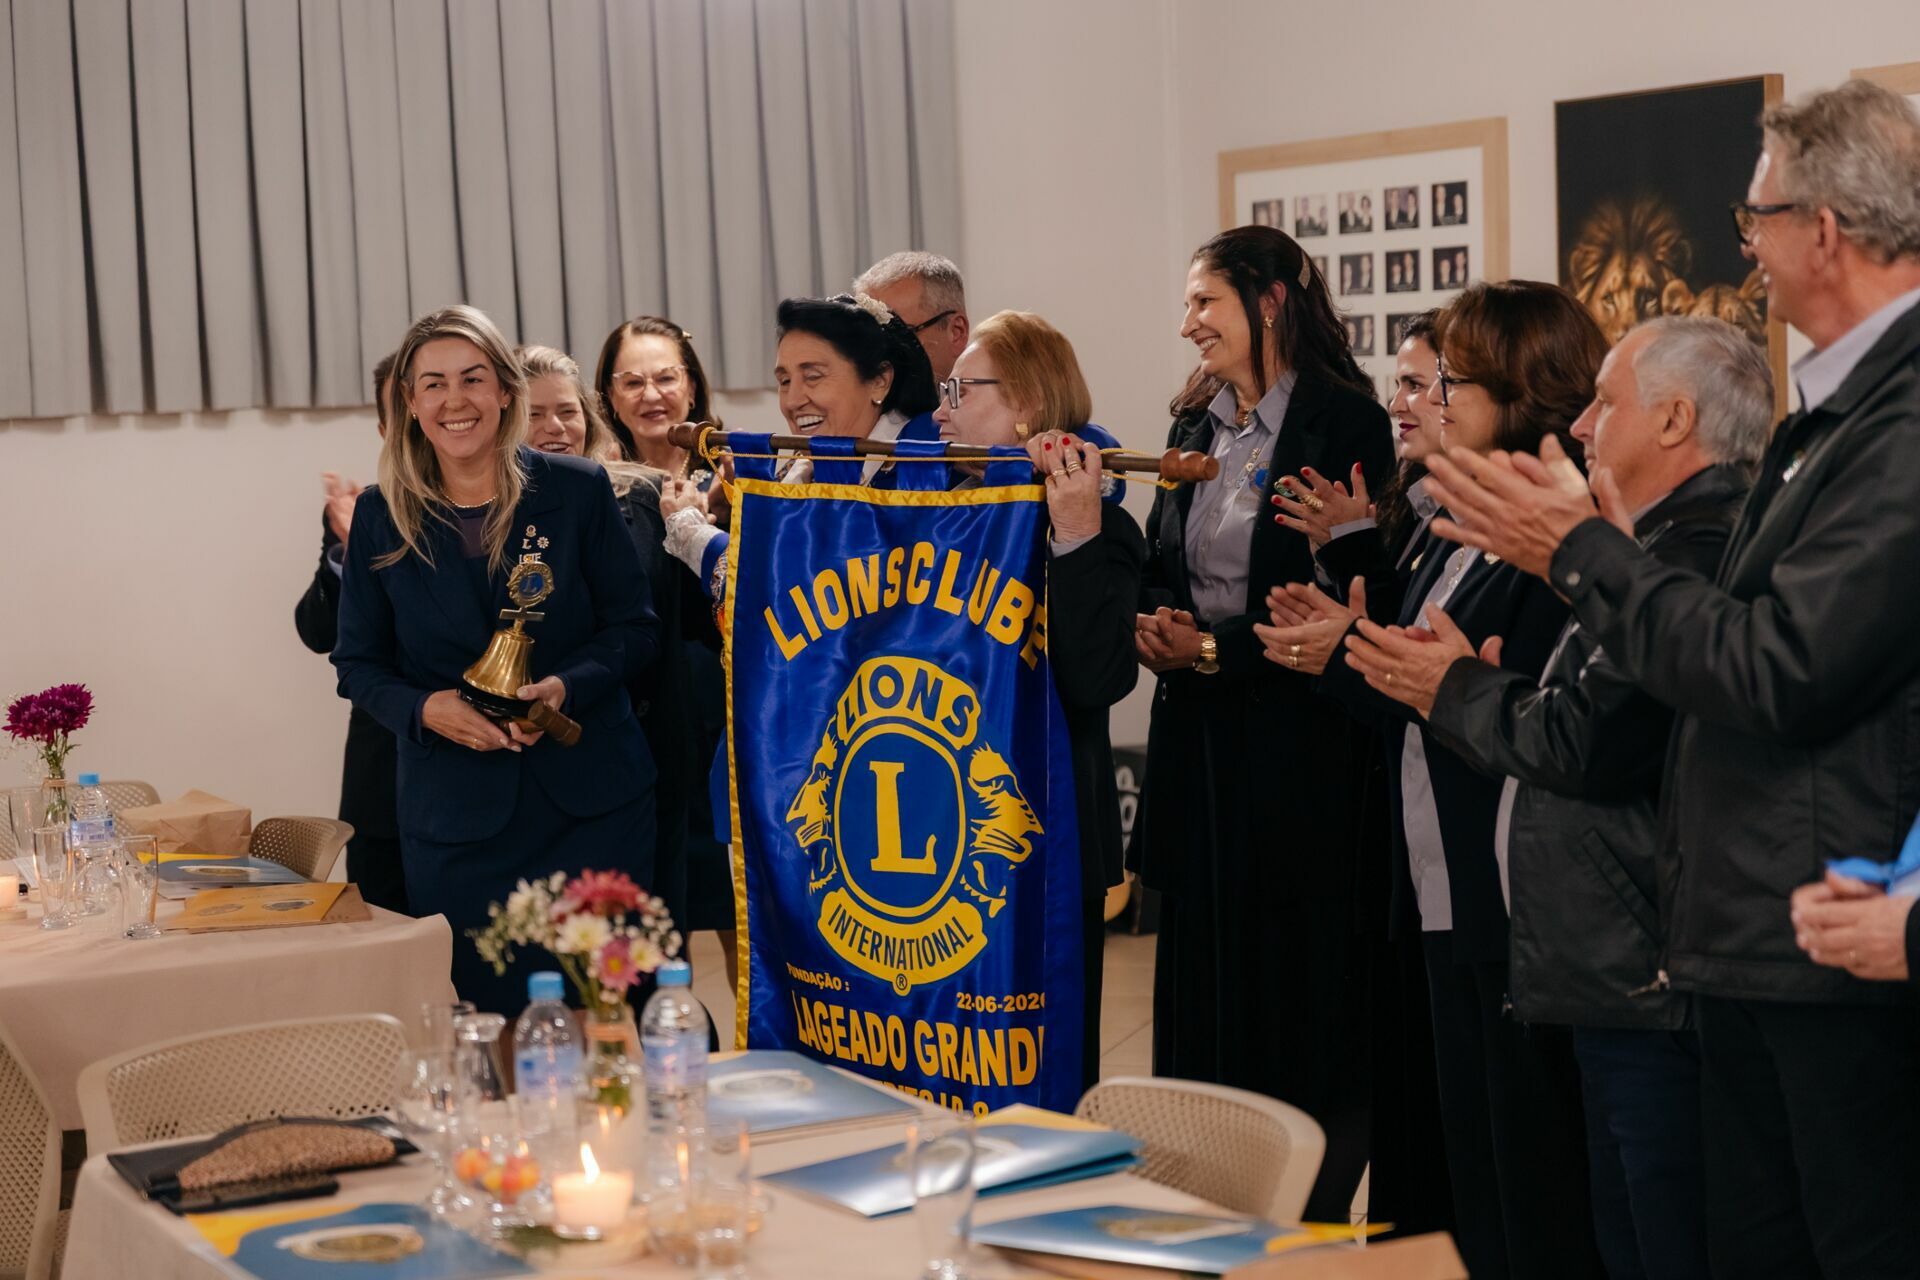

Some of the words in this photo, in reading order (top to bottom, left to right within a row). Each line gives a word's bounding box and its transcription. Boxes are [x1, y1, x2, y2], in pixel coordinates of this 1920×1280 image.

[841, 664, 974, 738] LIONS
[869, 760, 938, 875] L
[827, 903, 974, 971] INTERNATIONAL
[792, 990, 907, 1072] LAGEADO
[914, 1019, 1045, 1087] GRAND
